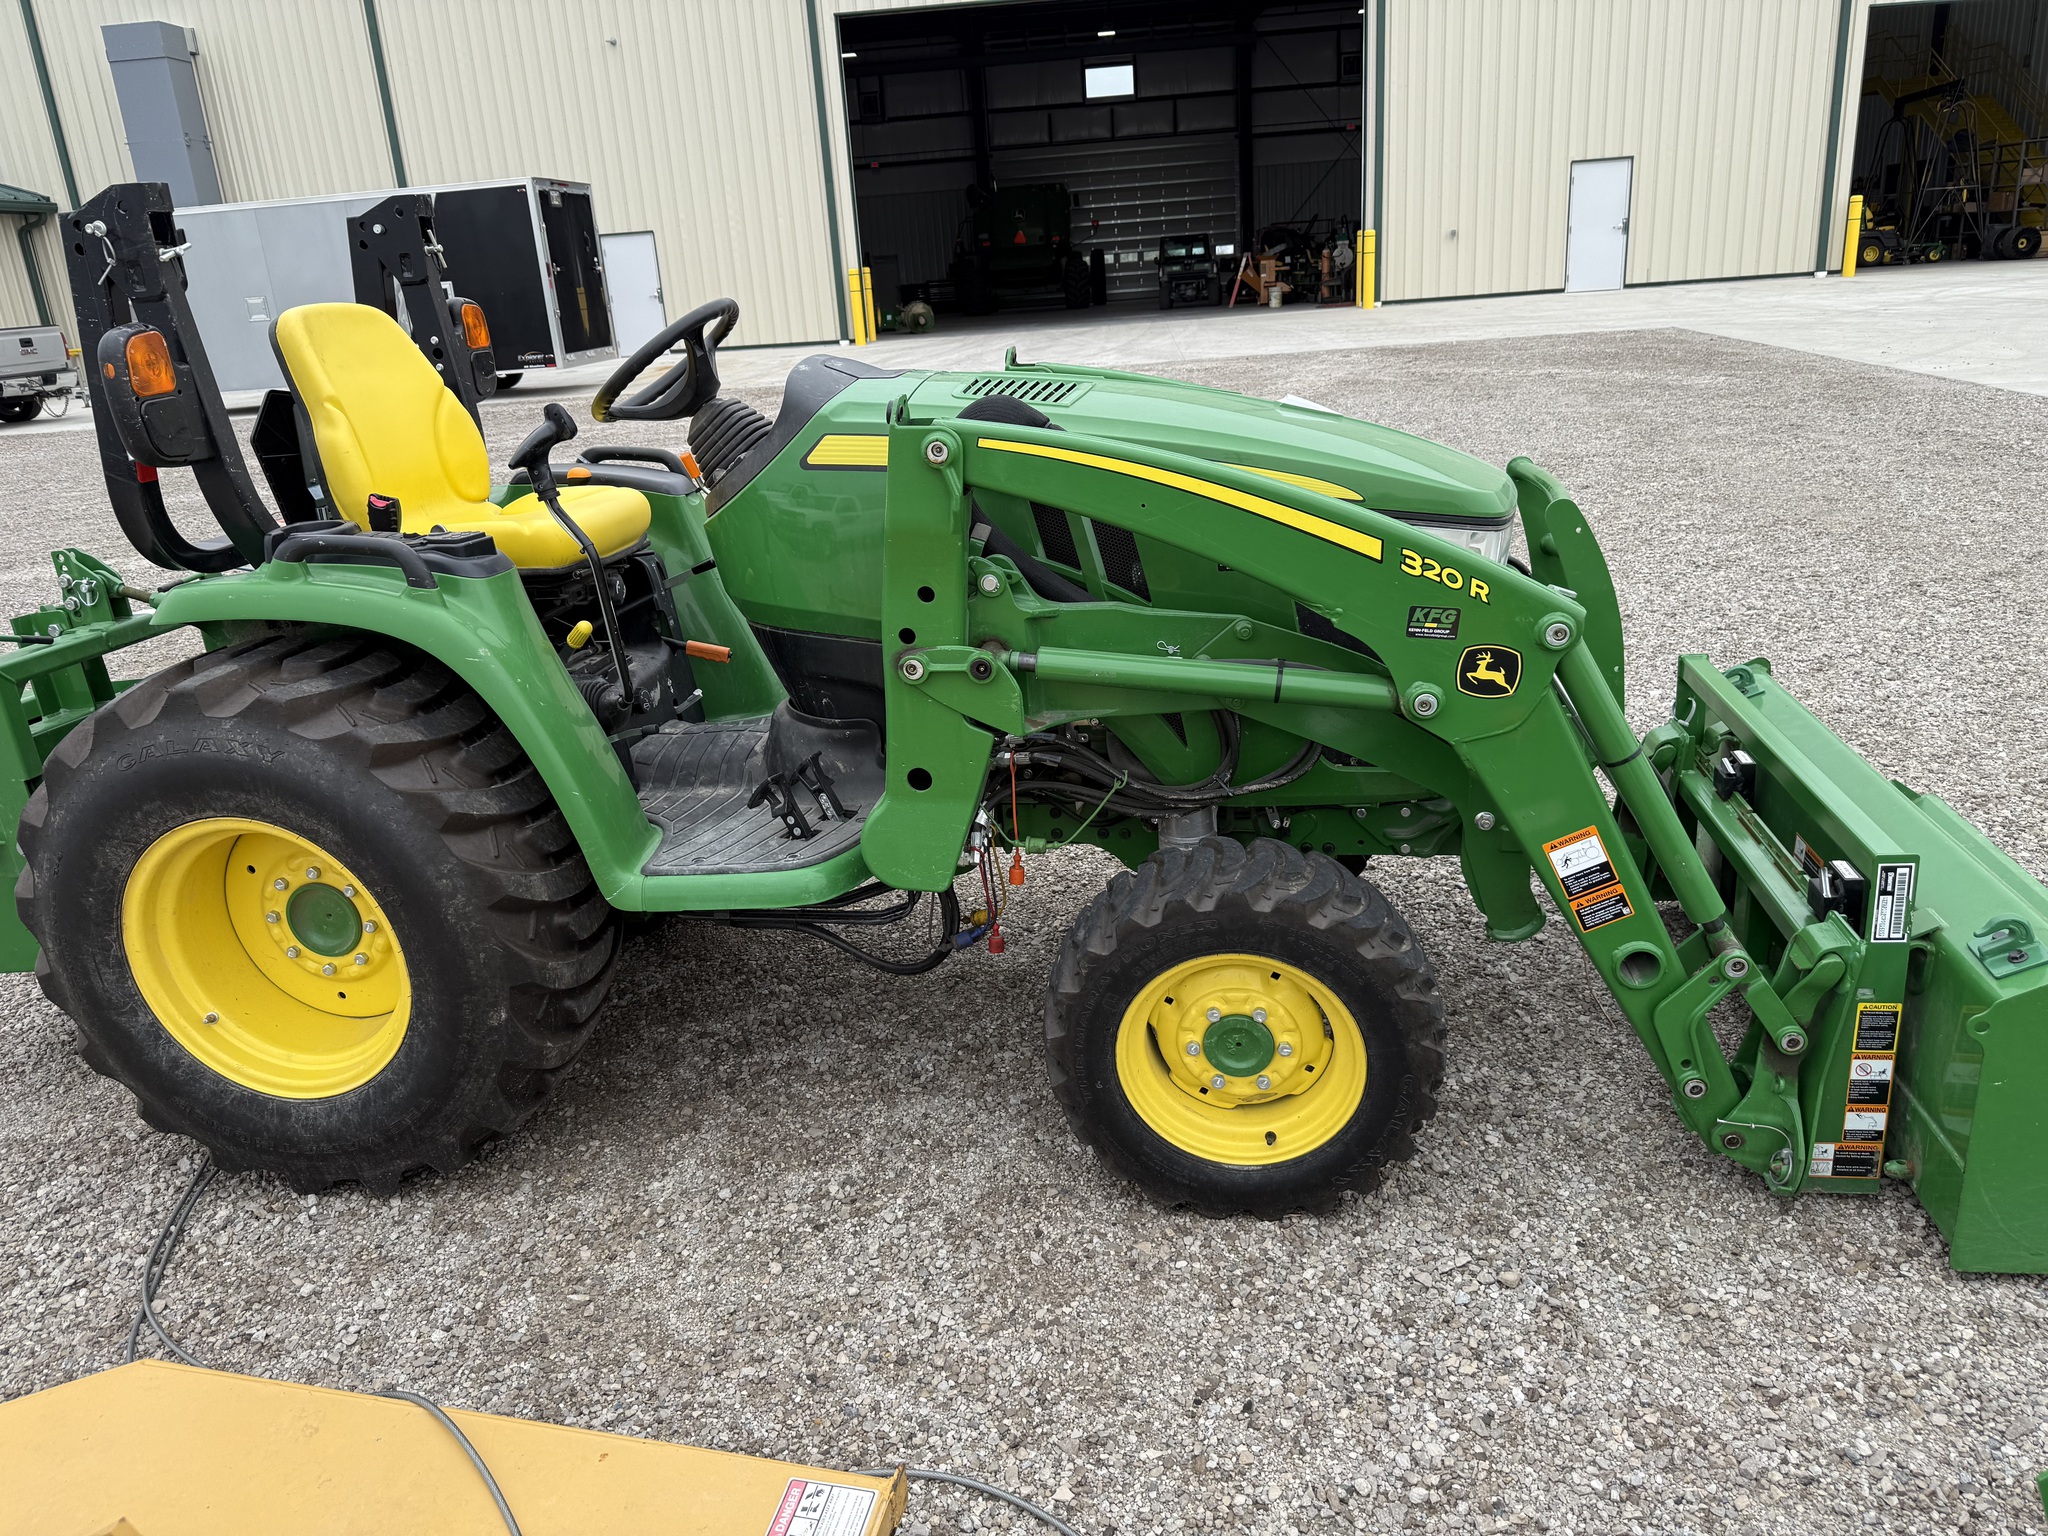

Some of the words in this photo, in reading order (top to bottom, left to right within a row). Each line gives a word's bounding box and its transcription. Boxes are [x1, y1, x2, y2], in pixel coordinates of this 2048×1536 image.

[1400, 548, 1464, 590] 320
[1469, 577, 1491, 604] R
[1412, 608, 1457, 624] KFG
[116, 737, 285, 771] GALAXY
[1557, 830, 1591, 847] WARNING
[1585, 888, 1618, 904] WARNING
[1075, 918, 1219, 1047] MARATHONER
[775, 1487, 802, 1535] DANGER
